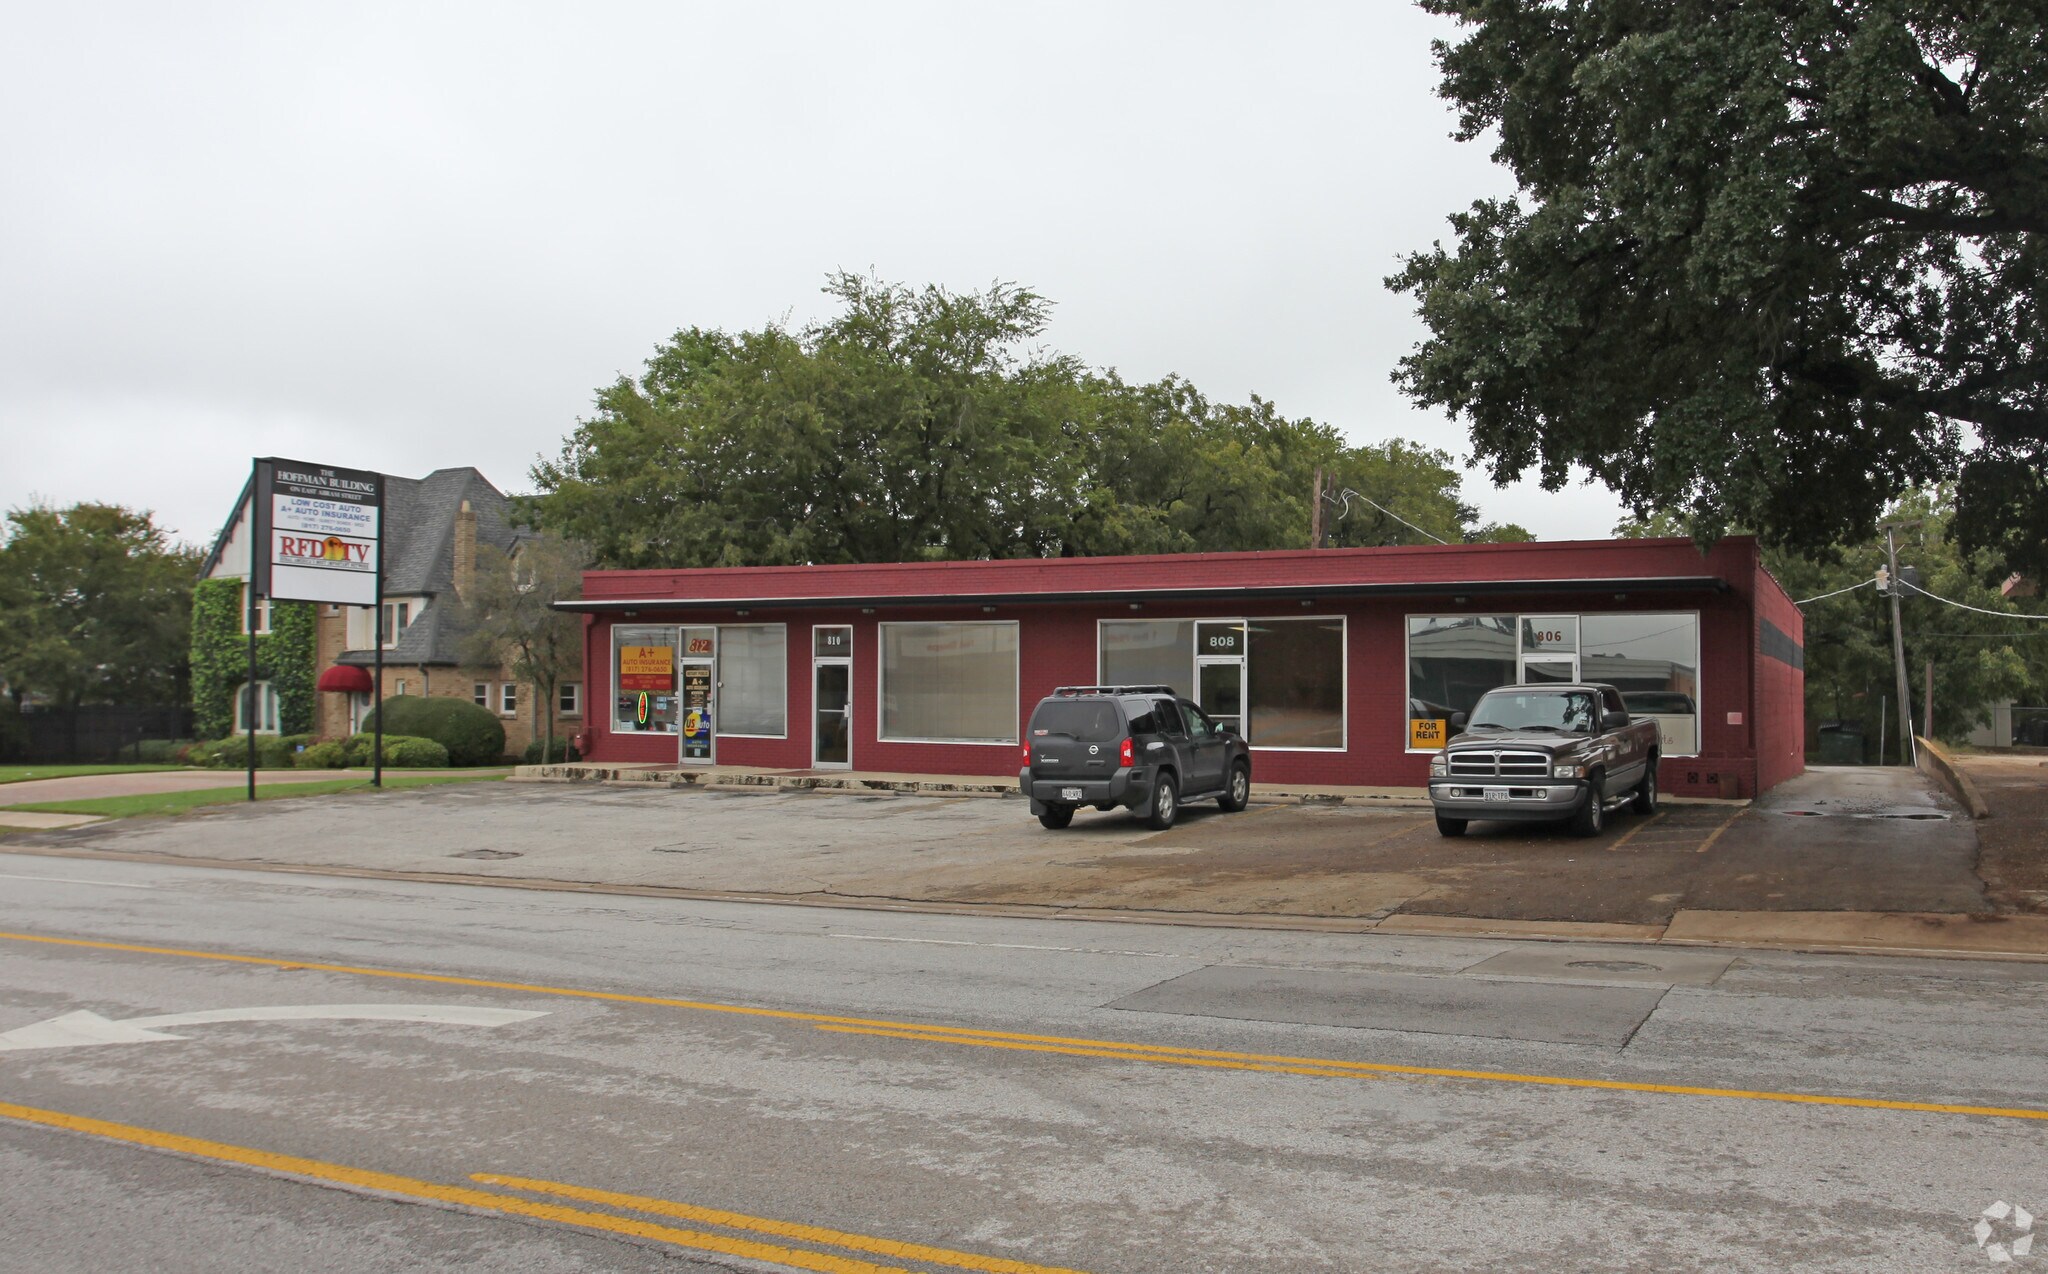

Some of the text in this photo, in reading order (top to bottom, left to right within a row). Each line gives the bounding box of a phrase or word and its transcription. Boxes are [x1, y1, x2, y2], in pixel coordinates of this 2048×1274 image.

[320, 469, 334, 477] THE
[277, 470, 374, 492] HOFFMAN BUILDING
[341, 492, 362, 500] STREET
[291, 498, 362, 513] LOW COST AUTO
[295, 507, 319, 516] AUTO
[322, 510, 370, 522] INSURANCE
[280, 536, 370, 562] RFD TV
[828, 636, 840, 645] 810
[1210, 636, 1234, 646] 808
[1536, 631, 1562, 642] 806
[688, 638, 712, 653] 812
[639, 648, 654, 658] A+
[686, 719, 696, 728] US
[1416, 731, 1440, 739] RENT
